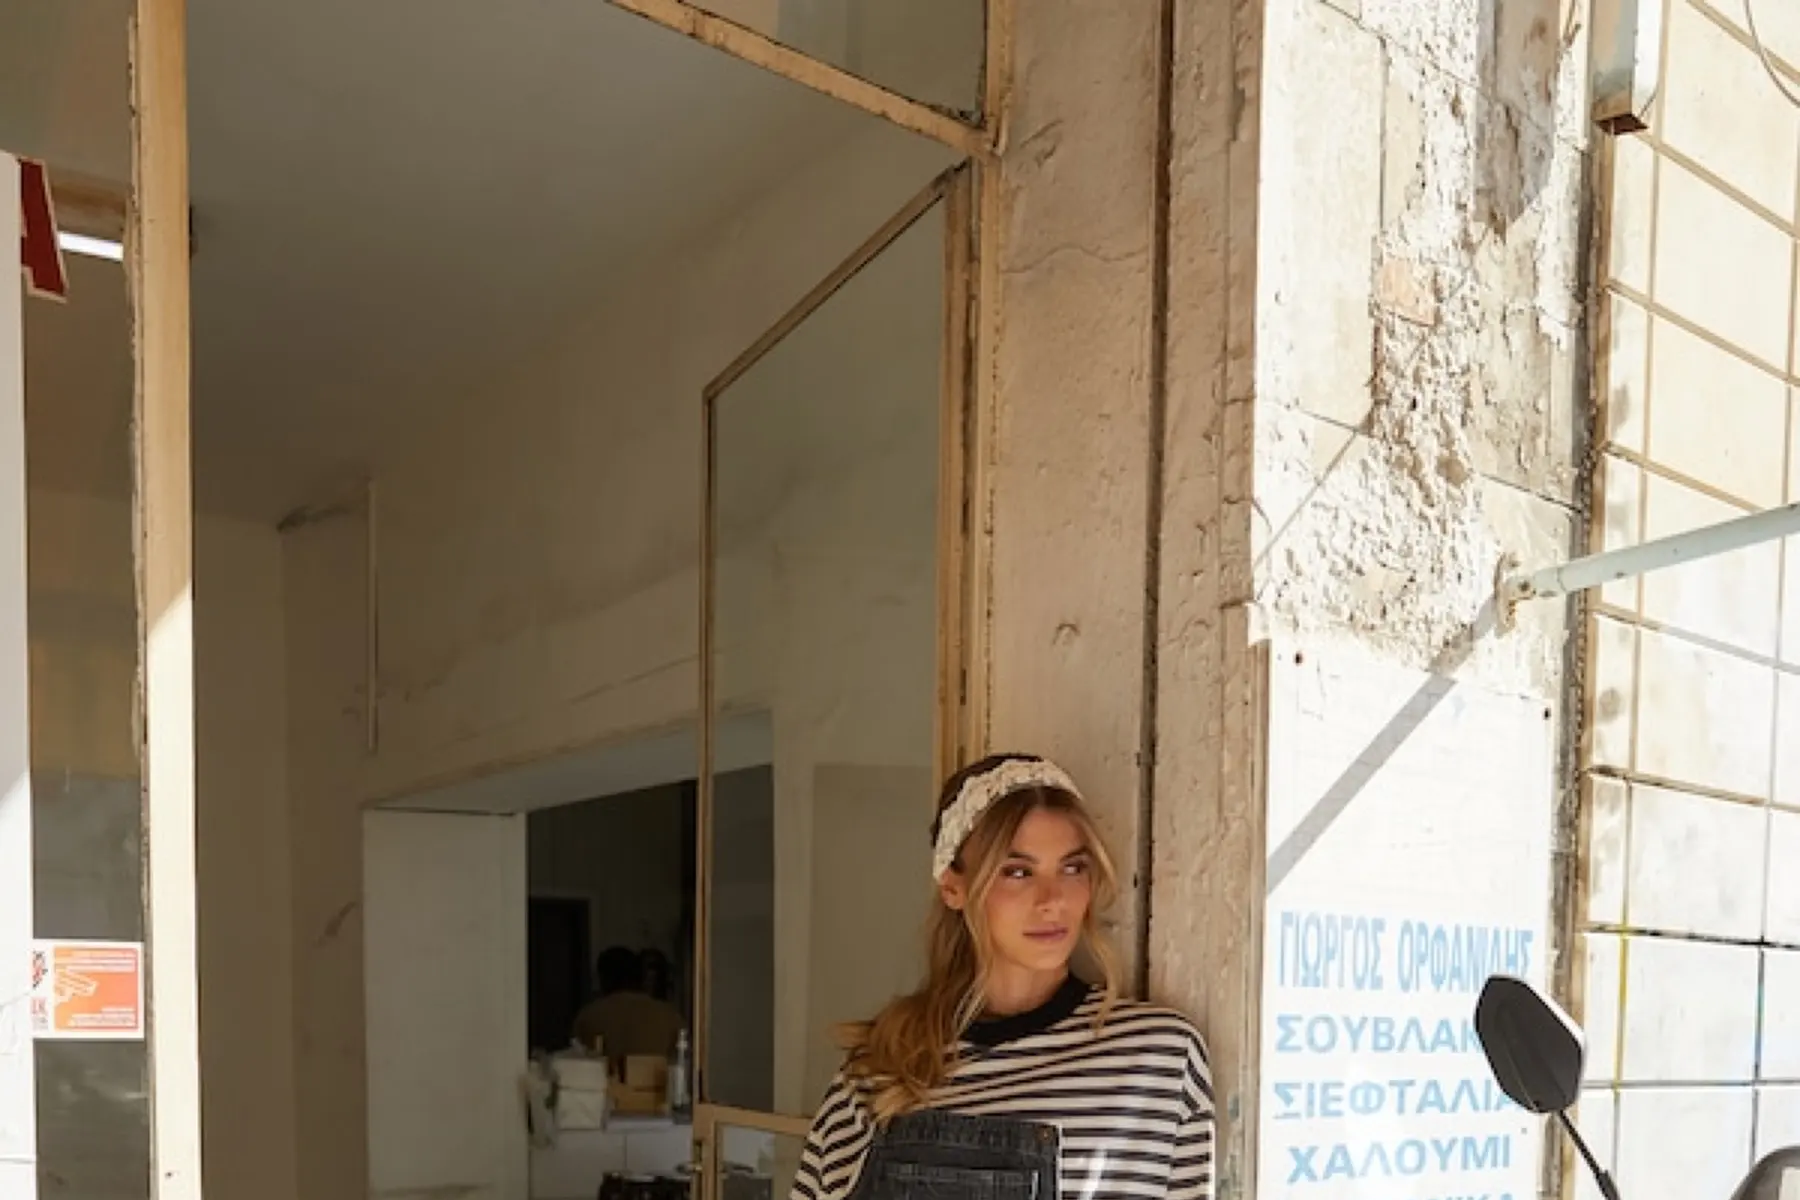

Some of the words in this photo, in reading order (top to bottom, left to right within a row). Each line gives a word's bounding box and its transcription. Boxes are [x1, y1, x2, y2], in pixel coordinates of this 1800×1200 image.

[1279, 911, 1387, 990] ΓΙΩΡΓΟΣ
[1275, 1014, 1484, 1053] ΣΟΥΒΛΑΚ
[1286, 1135, 1511, 1184] ΧΑΛΟΥΜΙ
